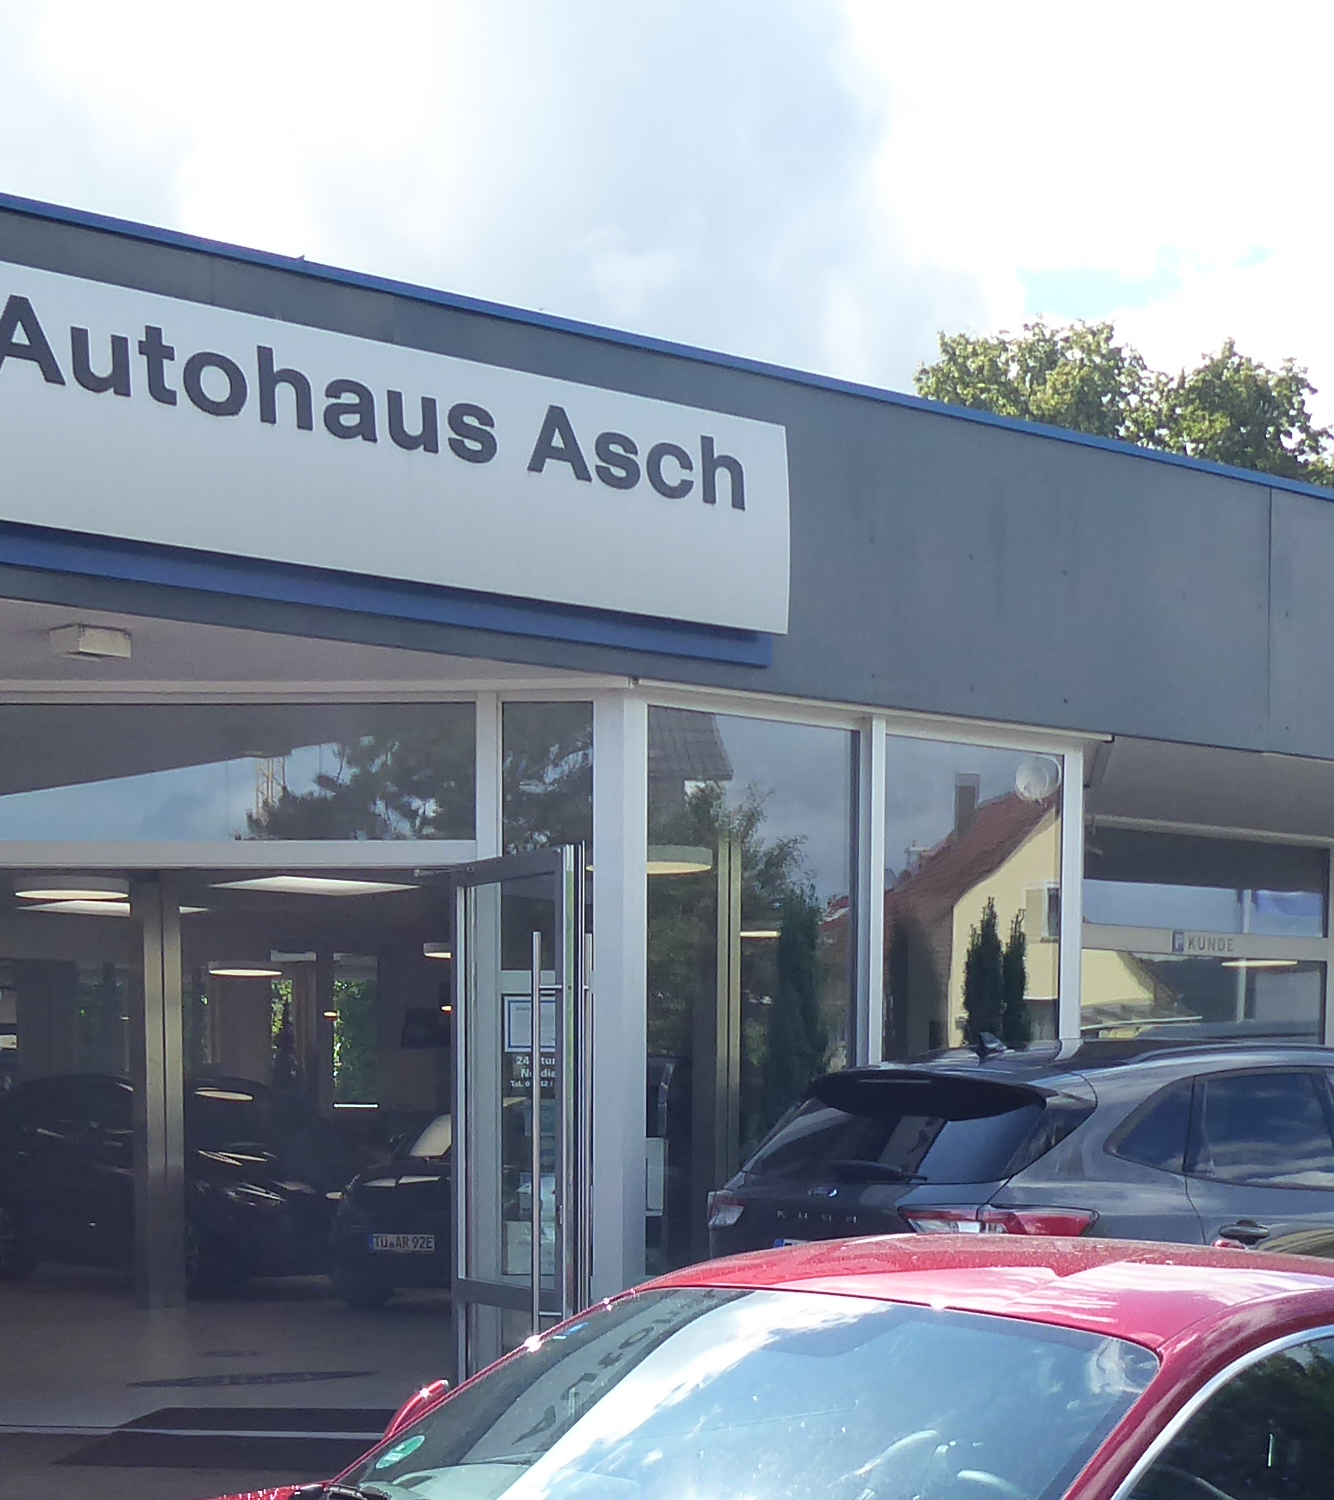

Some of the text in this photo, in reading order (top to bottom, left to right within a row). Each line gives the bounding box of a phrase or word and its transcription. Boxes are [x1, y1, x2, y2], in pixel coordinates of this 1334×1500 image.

[526, 404, 746, 511] Asch
[1187, 937, 1235, 952] KUNDE
[516, 1056, 530, 1065] 24
